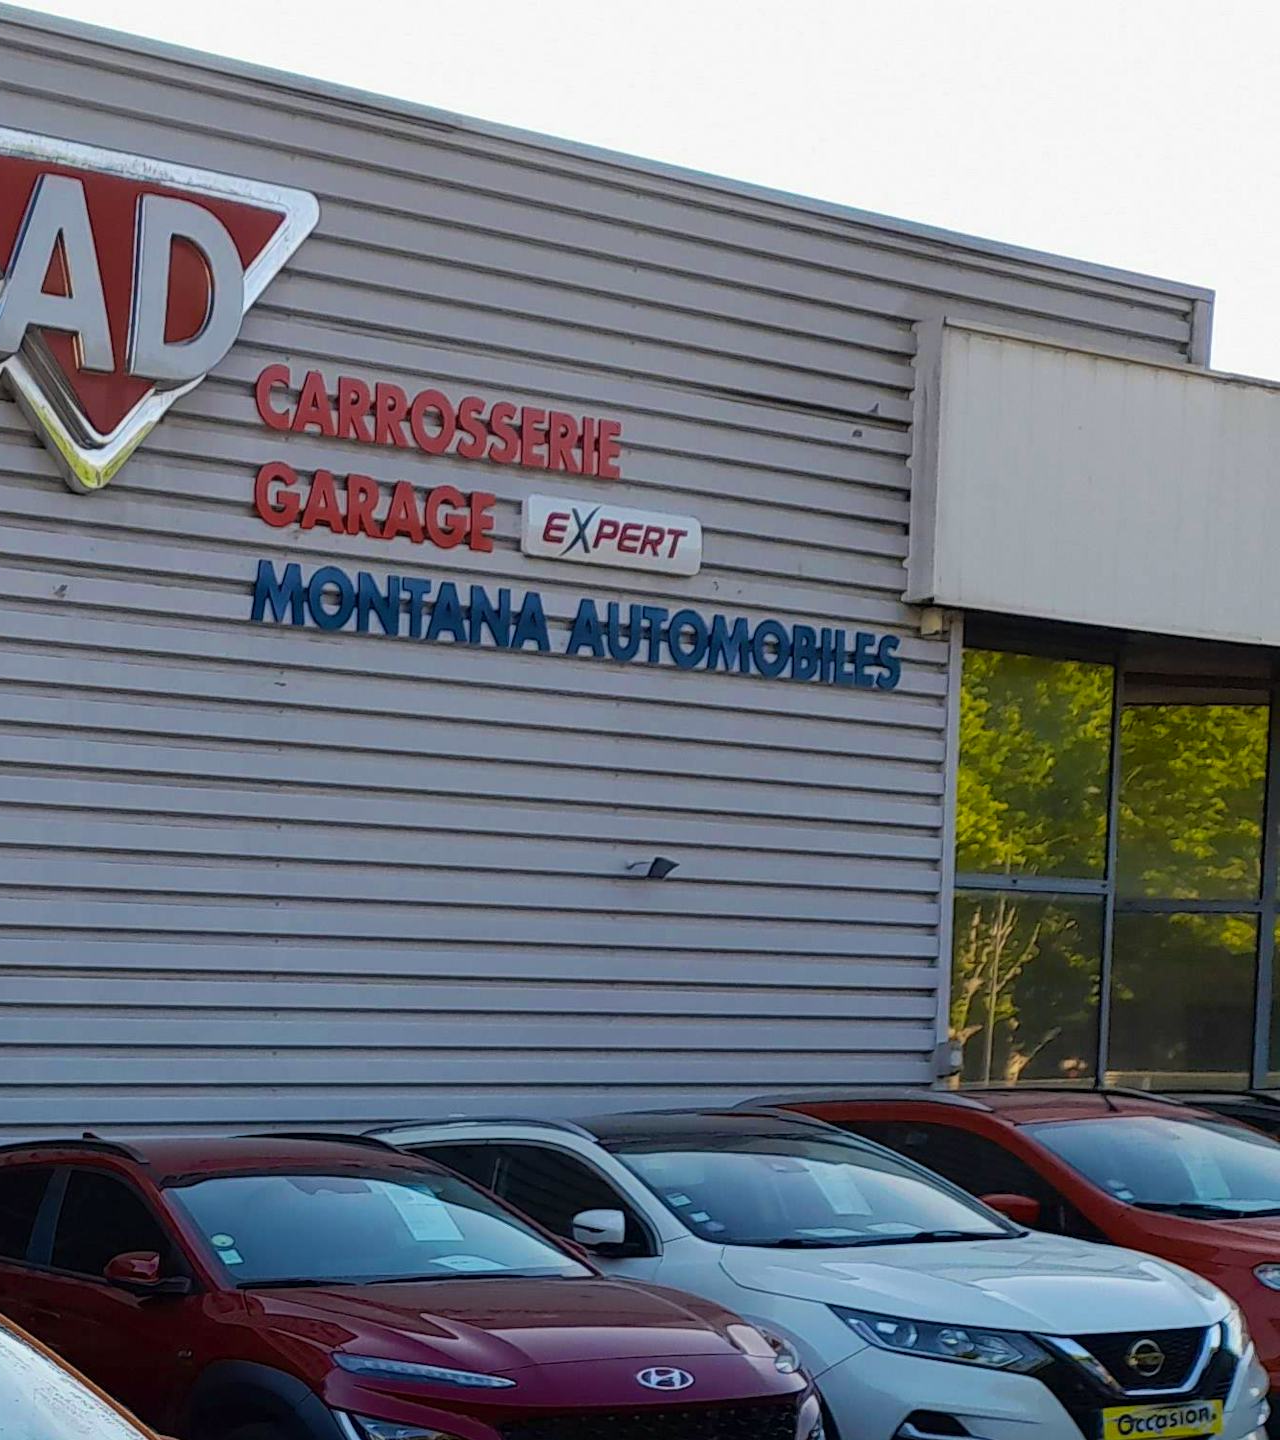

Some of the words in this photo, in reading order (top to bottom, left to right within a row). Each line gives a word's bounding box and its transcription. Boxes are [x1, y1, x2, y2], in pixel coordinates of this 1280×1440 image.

[255, 364, 621, 481] CARROSSERIE
[254, 462, 496, 553] GARAGE
[251, 559, 551, 652] MONTANA
[566, 598, 902, 691] AUTOMOBILES
